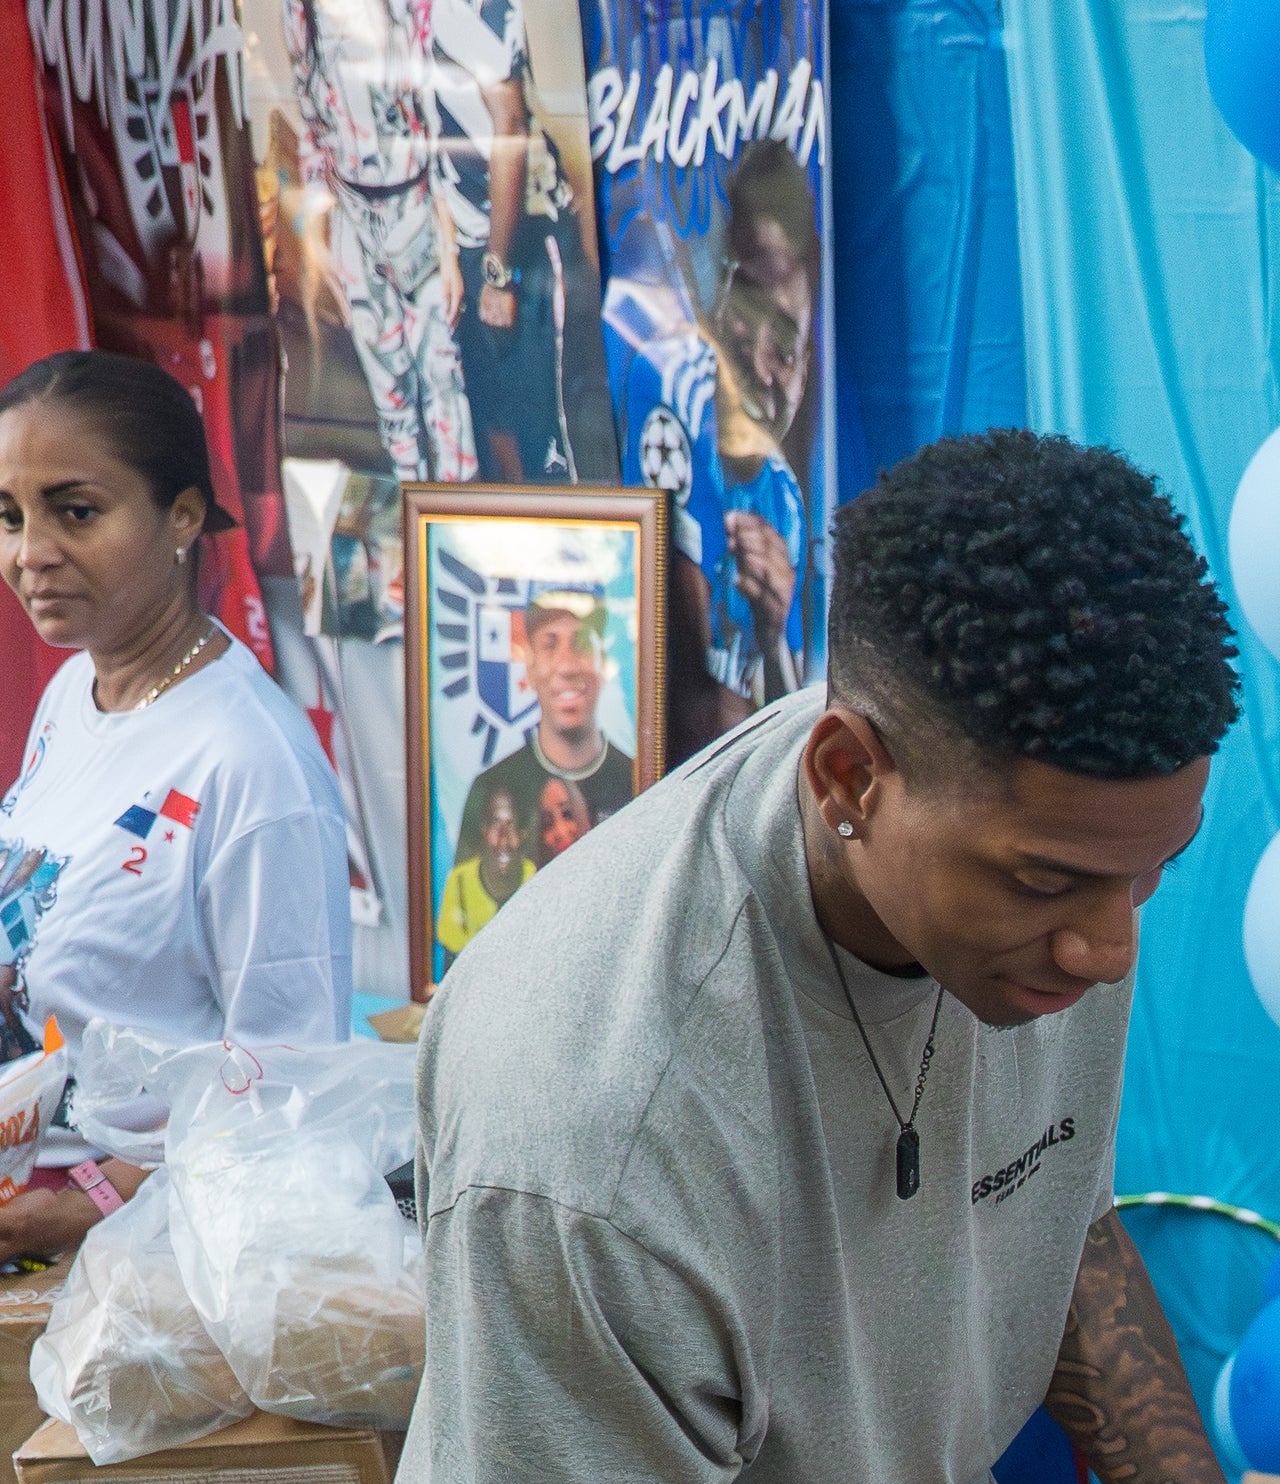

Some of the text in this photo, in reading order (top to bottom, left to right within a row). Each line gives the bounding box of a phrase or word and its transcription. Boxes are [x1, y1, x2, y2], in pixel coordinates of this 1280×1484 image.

[588, 57, 826, 174] BLACKMAN
[121, 846, 148, 877] 2
[971, 1117, 1075, 1205] ESSENTIALS
